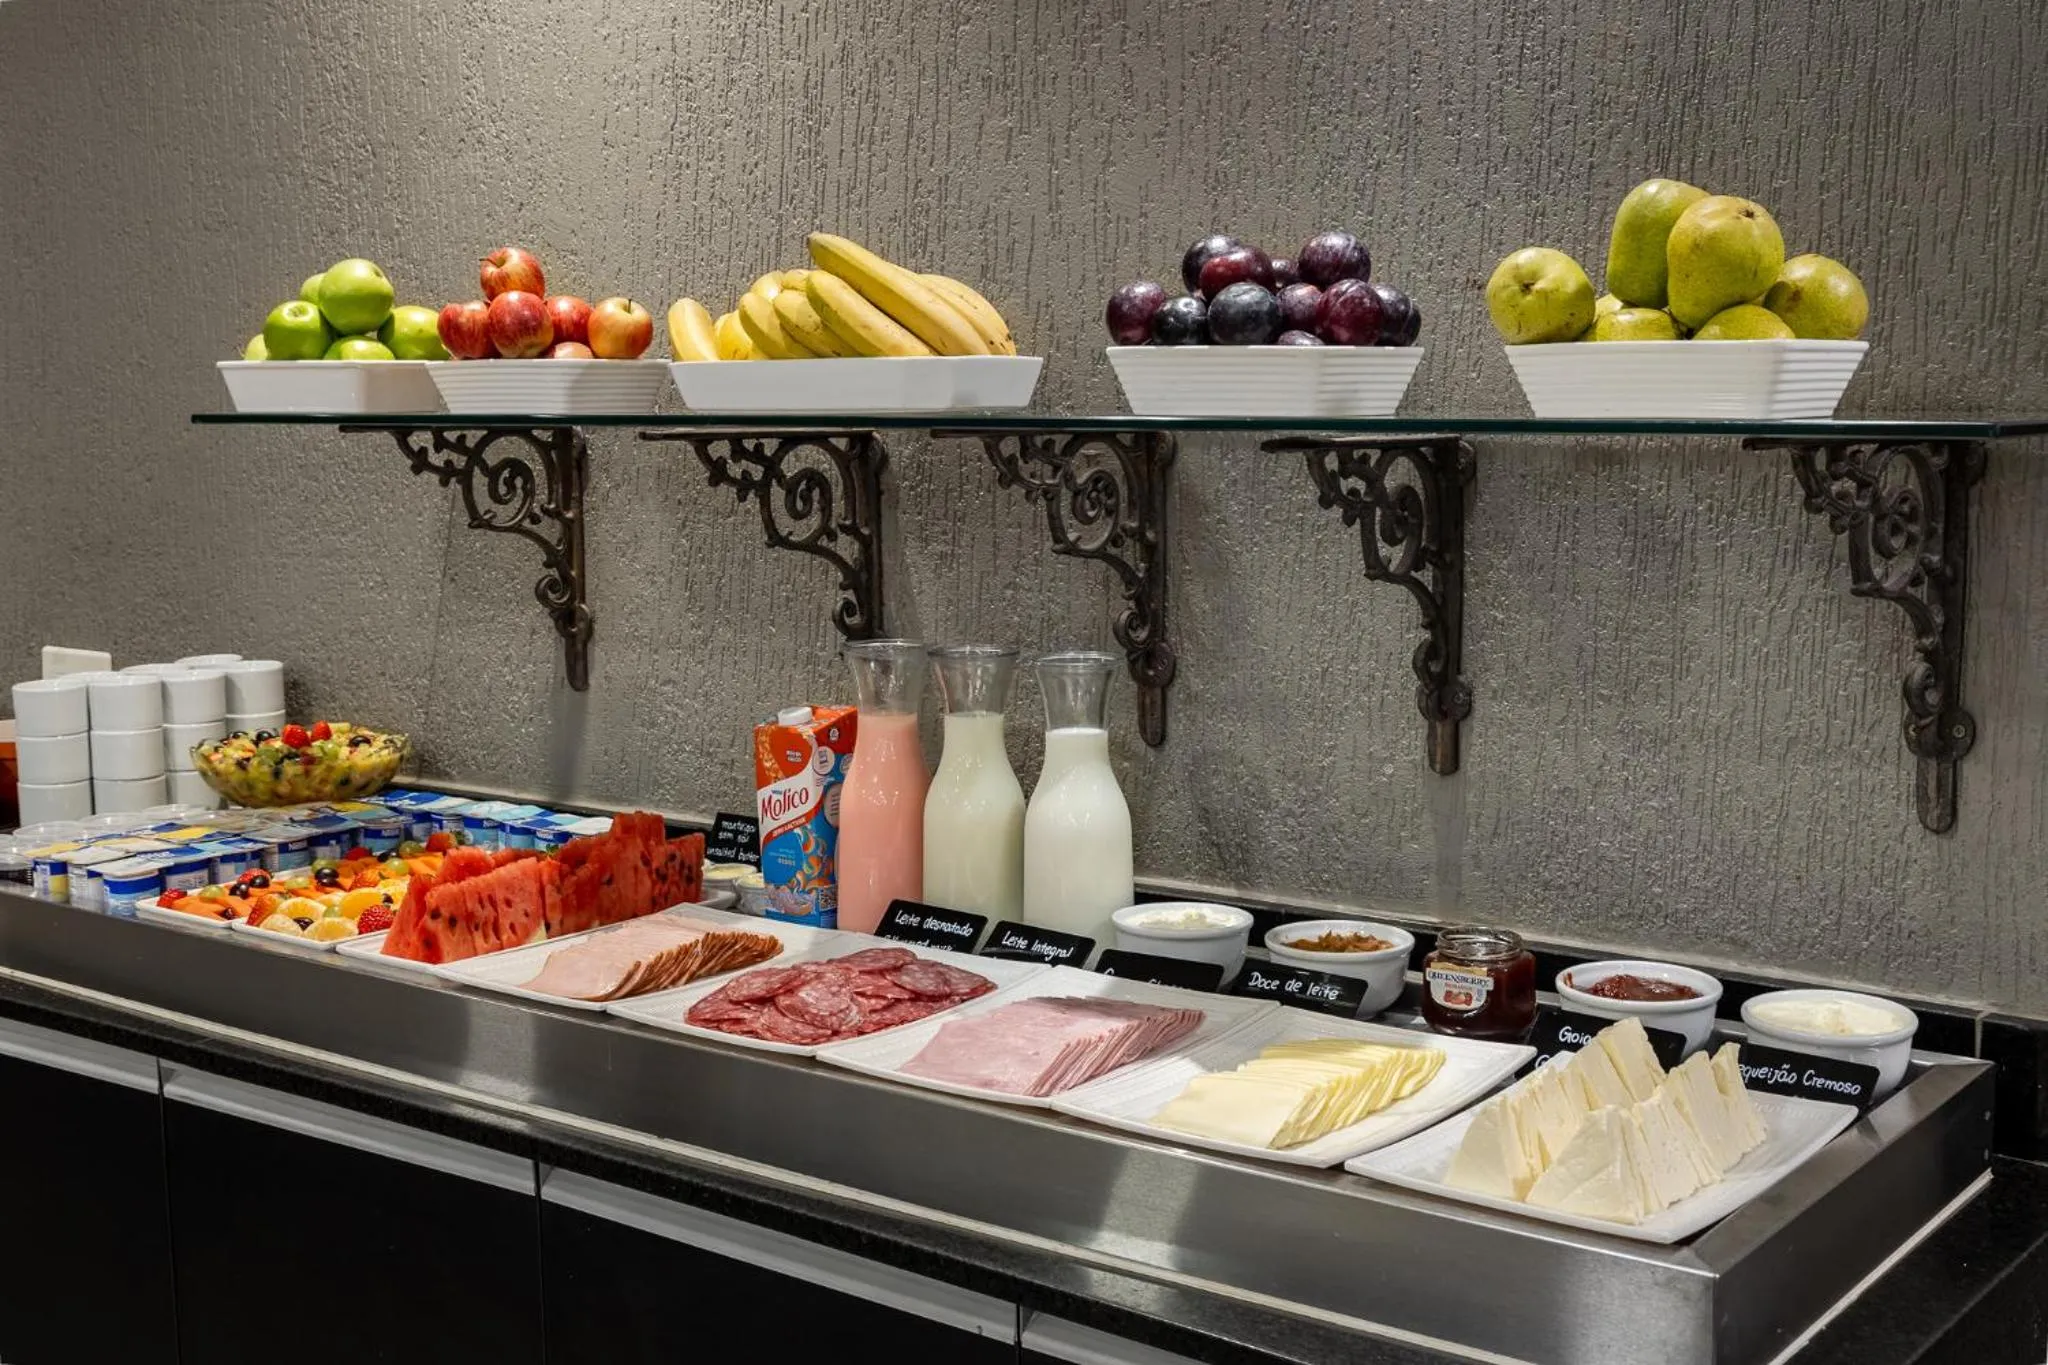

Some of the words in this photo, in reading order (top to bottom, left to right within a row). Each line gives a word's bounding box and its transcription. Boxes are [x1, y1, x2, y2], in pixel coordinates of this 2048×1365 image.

[761, 787, 809, 825] Molico
[895, 909, 921, 927] Leite
[922, 915, 974, 937] desnatado
[1001, 930, 1029, 950] Leite
[1247, 971, 1280, 990] Doce
[1284, 978, 1303, 993] de
[1306, 982, 1339, 1001] leite
[1558, 1025, 1593, 1045] Goia
[1739, 1063, 1798, 1085] equeijão
[1802, 1069, 1862, 1096] Cremoso
